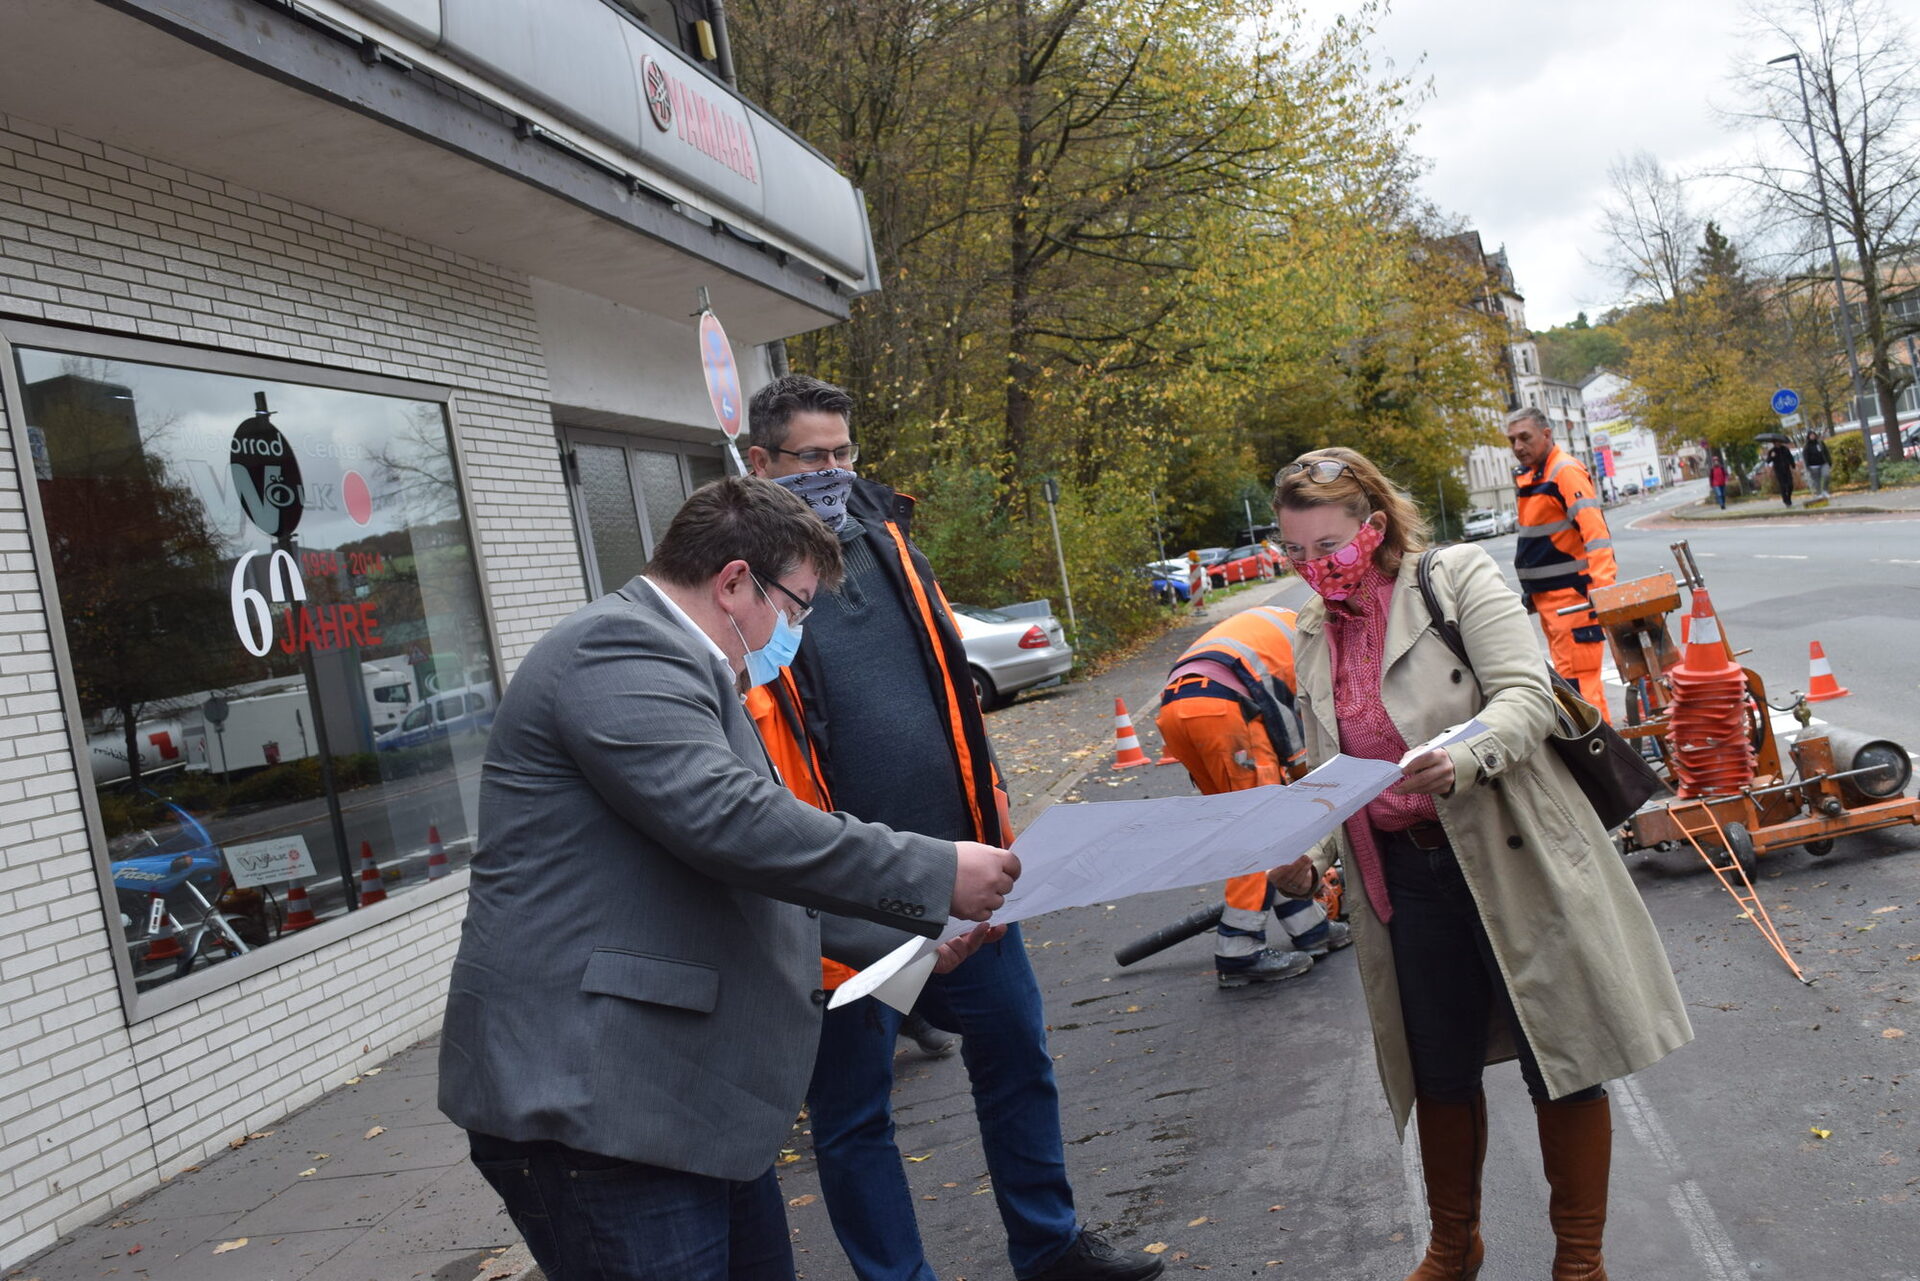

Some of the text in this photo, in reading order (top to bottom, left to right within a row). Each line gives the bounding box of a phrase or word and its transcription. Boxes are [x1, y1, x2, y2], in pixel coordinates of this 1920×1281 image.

[661, 69, 758, 185] YAMAHA
[302, 552, 339, 577] 1954
[351, 552, 384, 576] 2014
[279, 602, 384, 655] JAHRE
